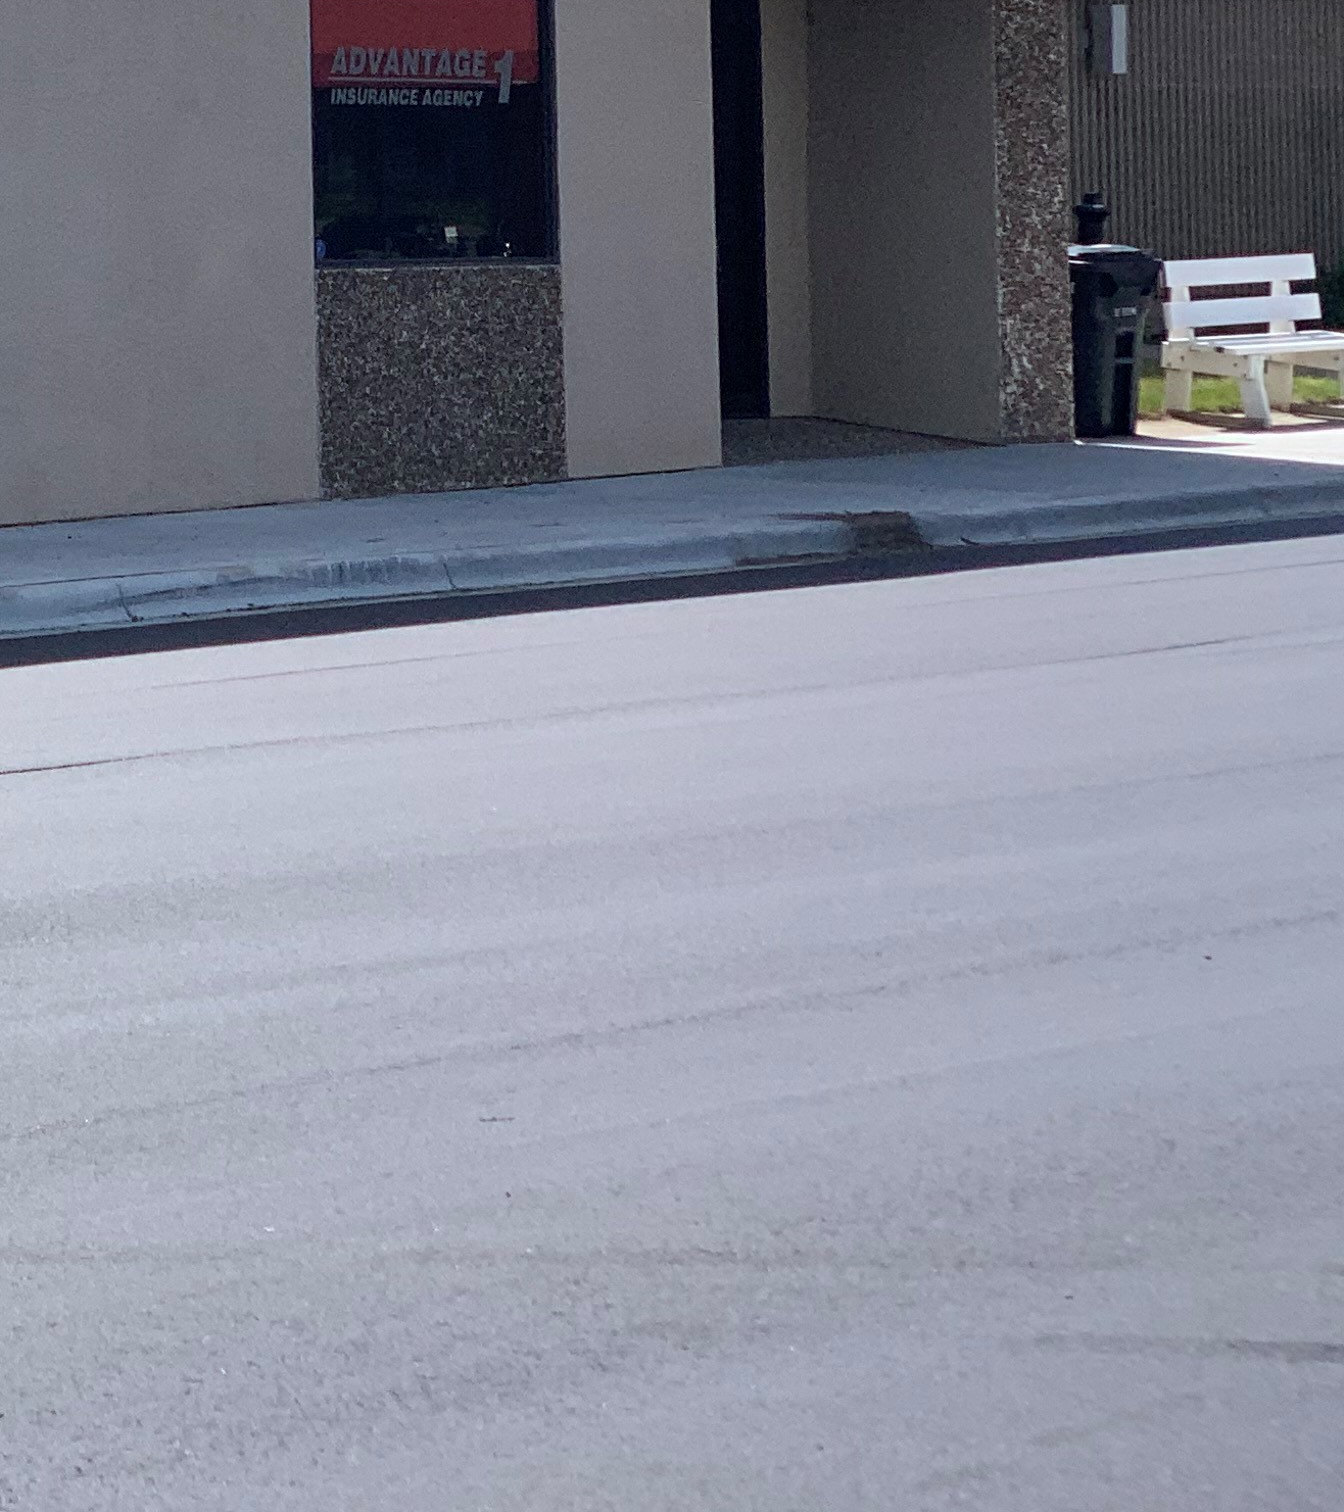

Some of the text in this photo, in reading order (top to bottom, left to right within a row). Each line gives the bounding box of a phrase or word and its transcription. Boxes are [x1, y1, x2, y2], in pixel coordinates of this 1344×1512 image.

[330, 46, 514, 104] ADVANTAGE 1
[330, 88, 483, 106] INSURANCE AGENCY
